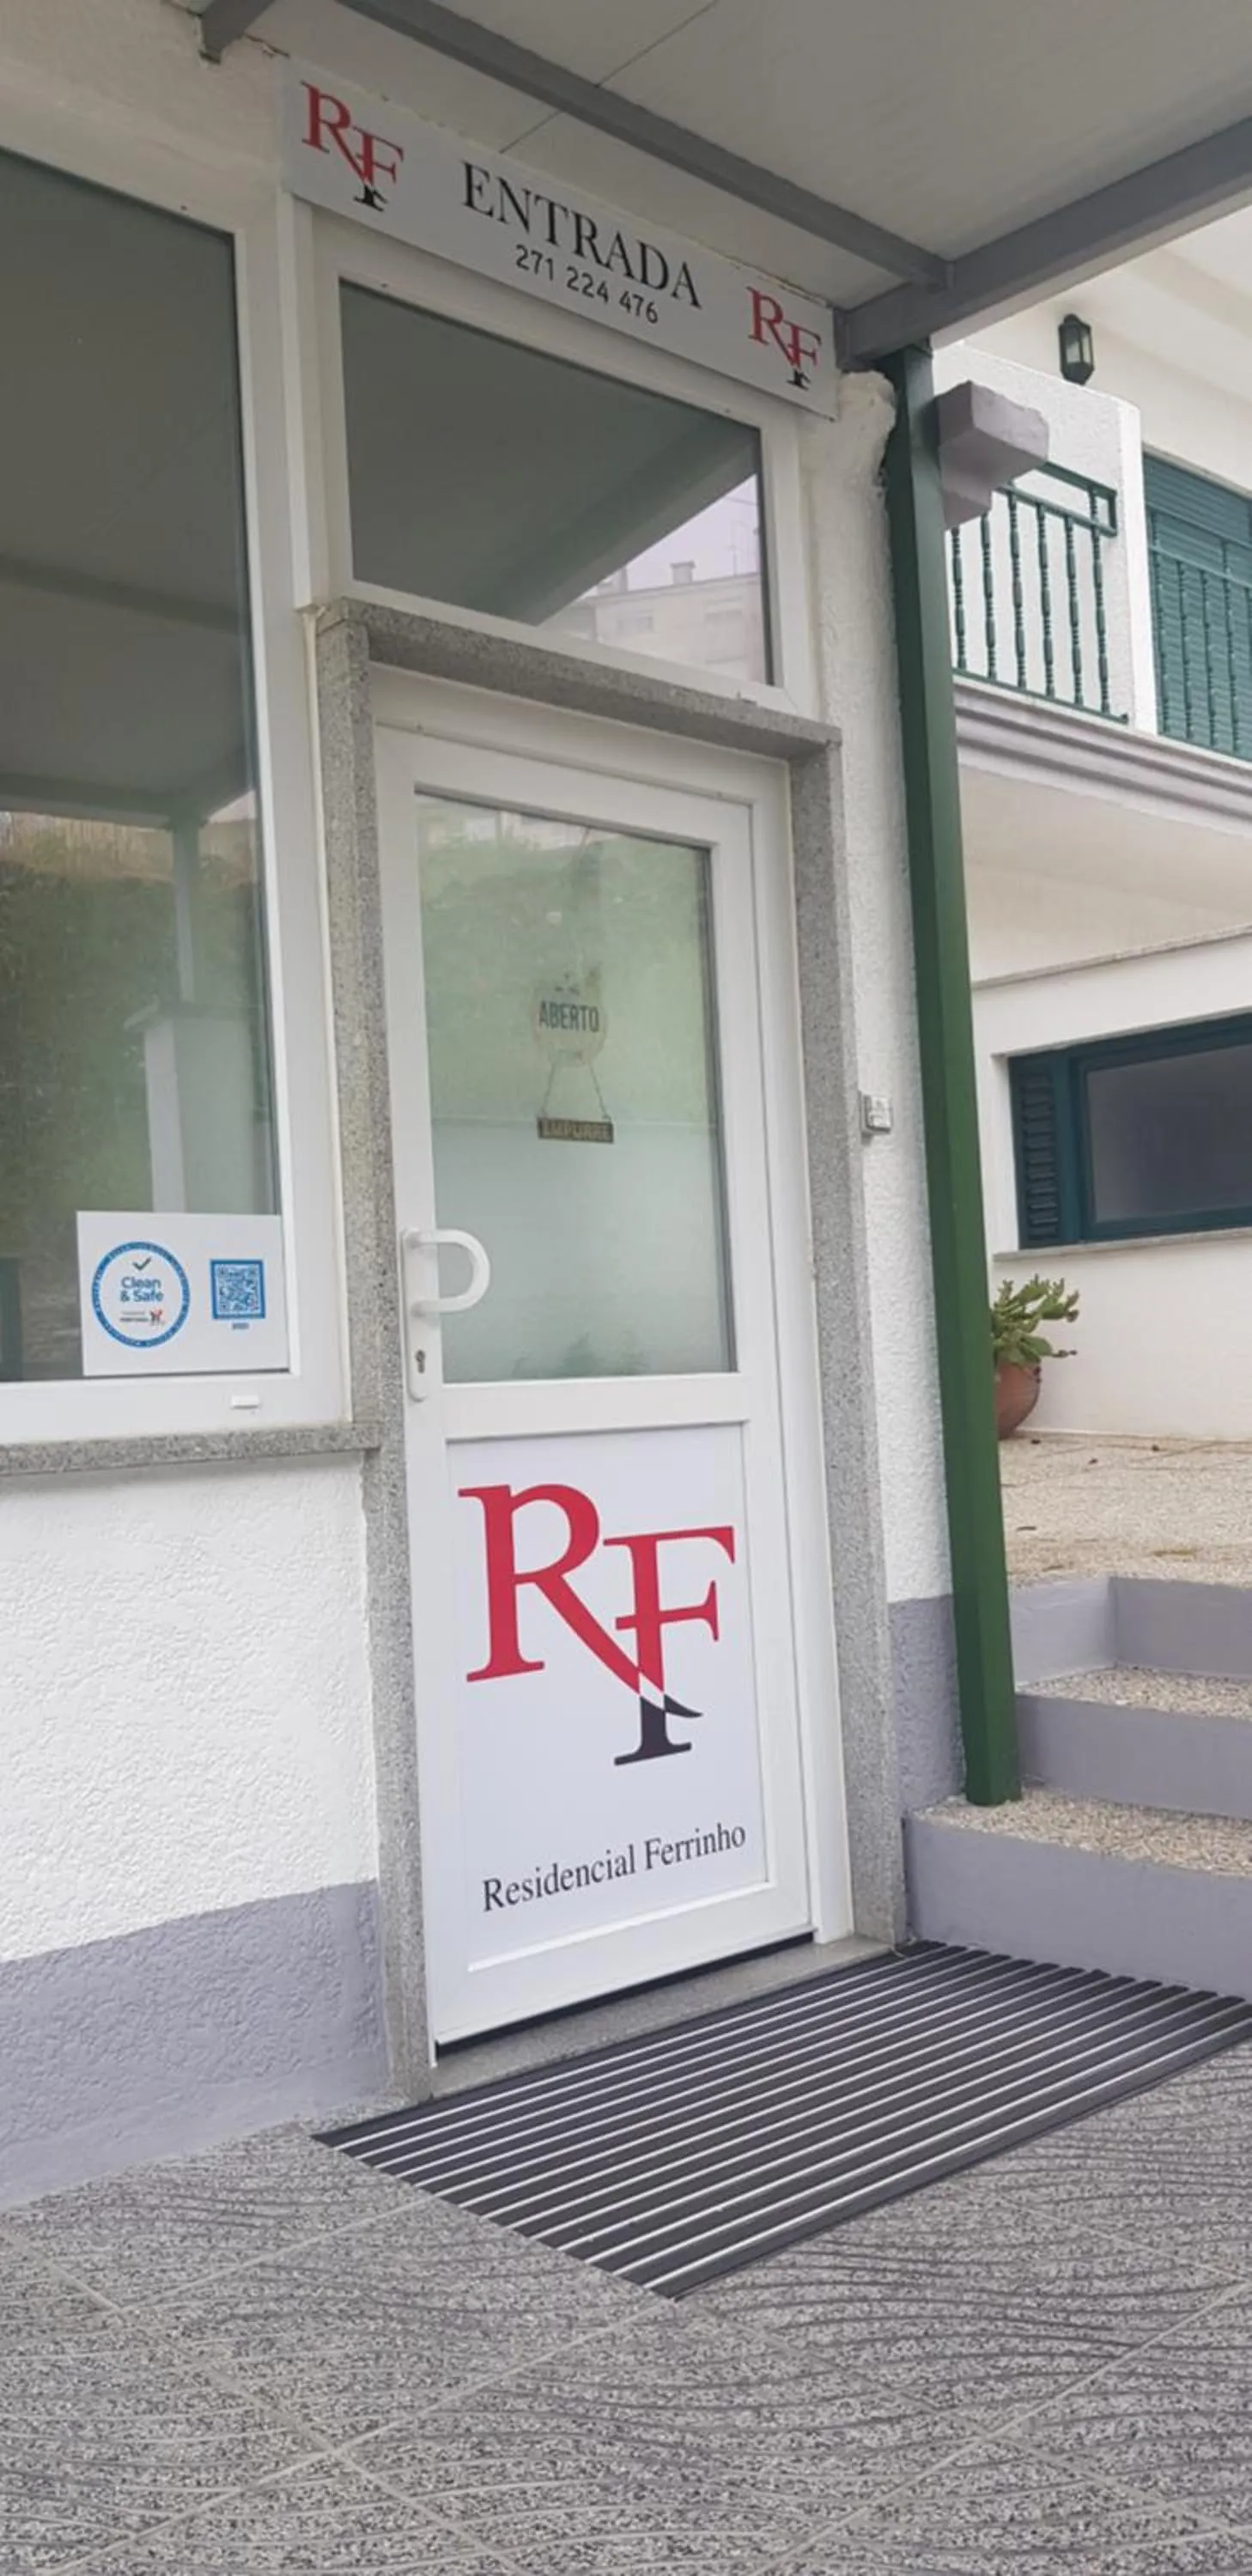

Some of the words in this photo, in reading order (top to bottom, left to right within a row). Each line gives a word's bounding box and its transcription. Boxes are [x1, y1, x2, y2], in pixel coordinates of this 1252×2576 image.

[462, 161, 702, 310] ENTRADA
[515, 245, 554, 281] 271
[566, 265, 609, 304] 224
[618, 290, 659, 325] 476
[538, 1001, 599, 1033] ABERTO
[120, 1290, 130, 1302] &
[133, 1290, 164, 1303] Safe
[121, 1277, 161, 1289] Clean
[483, 1844, 635, 1912] Residencial
[644, 1821, 746, 1870] Ferrinho
